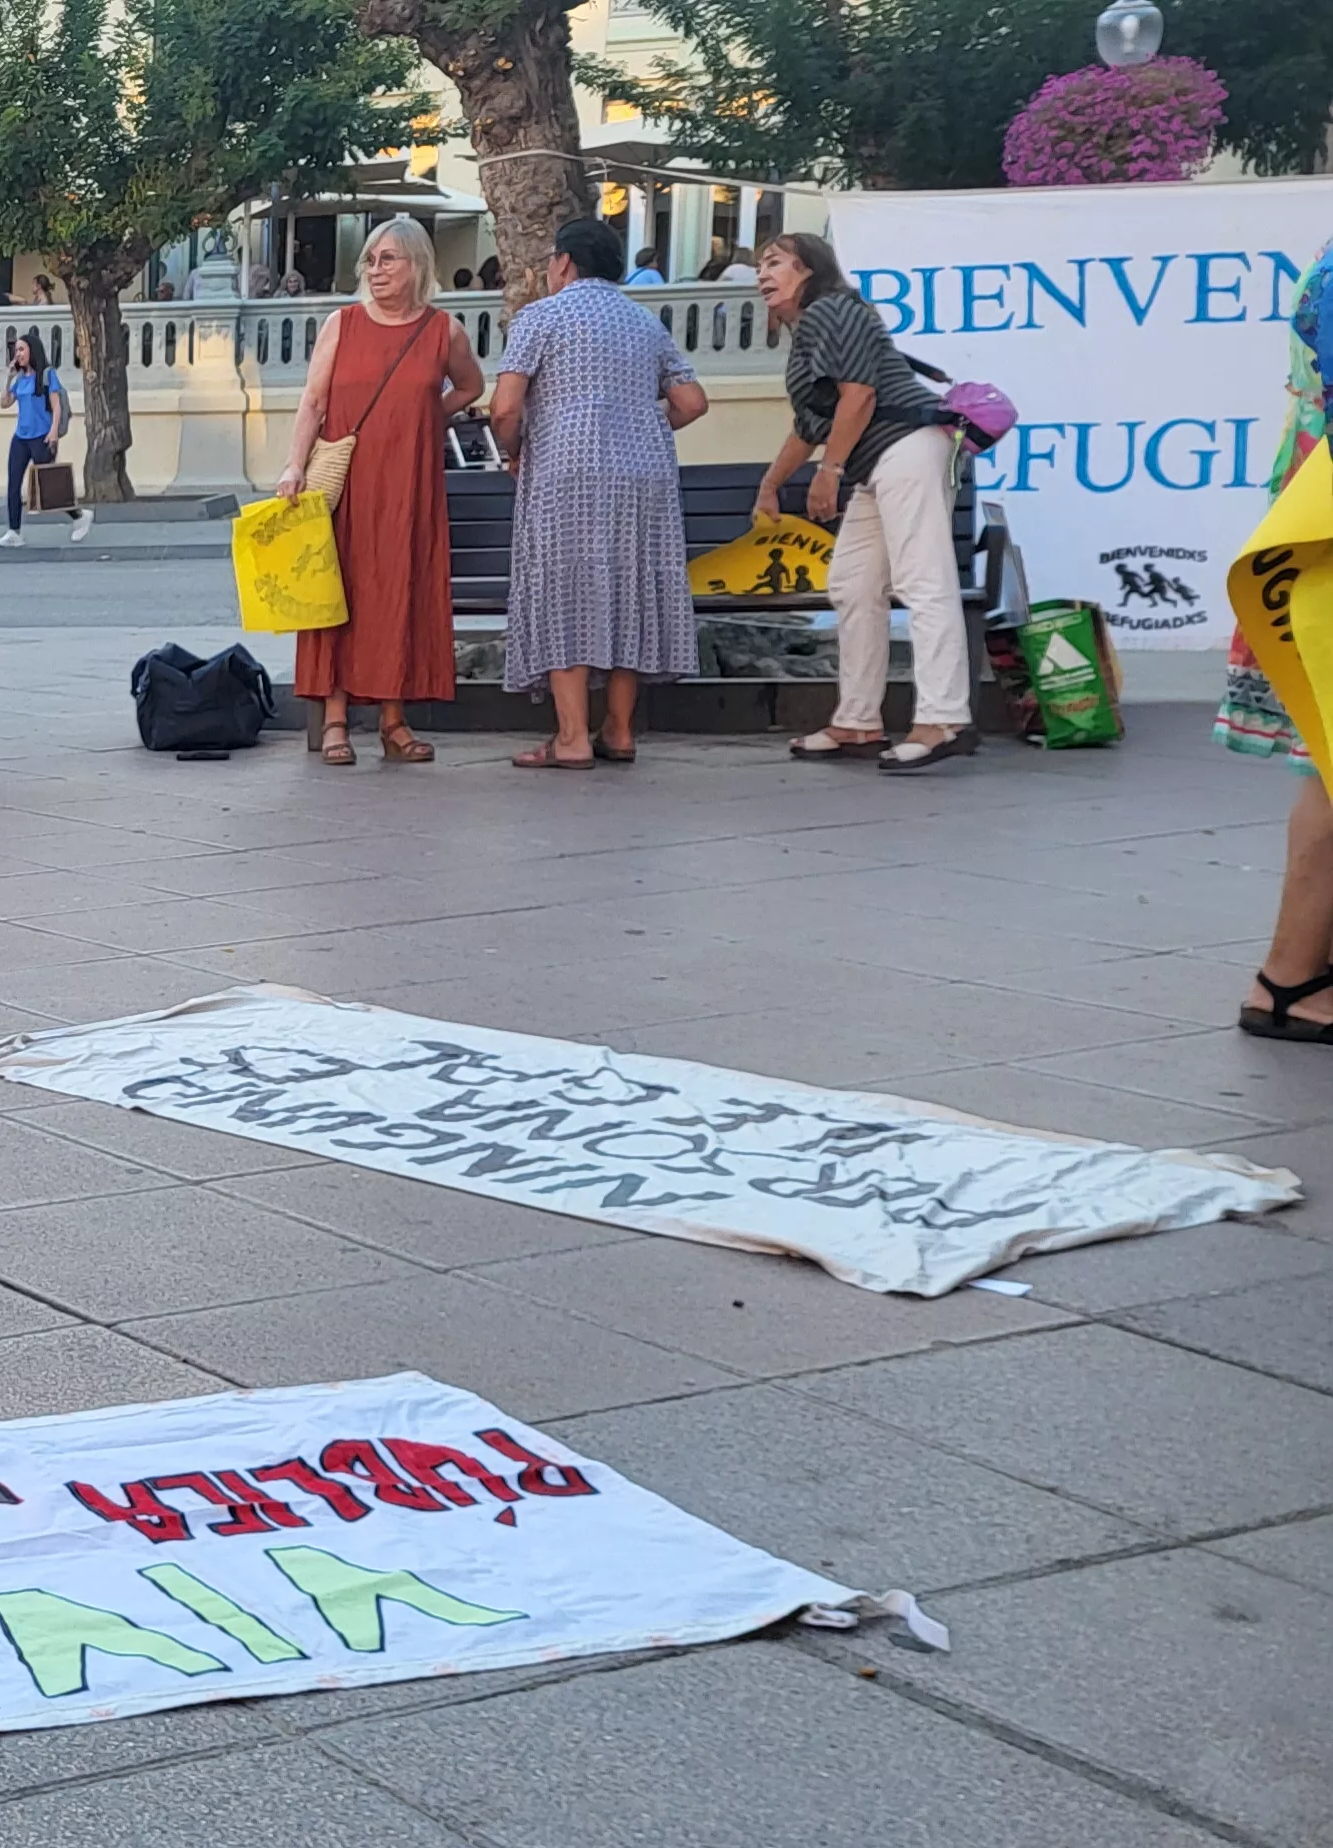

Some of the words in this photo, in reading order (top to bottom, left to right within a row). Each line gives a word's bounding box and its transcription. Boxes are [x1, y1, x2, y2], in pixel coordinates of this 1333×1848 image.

[1099, 545, 1208, 564] BIENVENIDXS
[123, 1067, 735, 1208] NINGUNA
[66, 1428, 599, 1544] PÚBLICA
